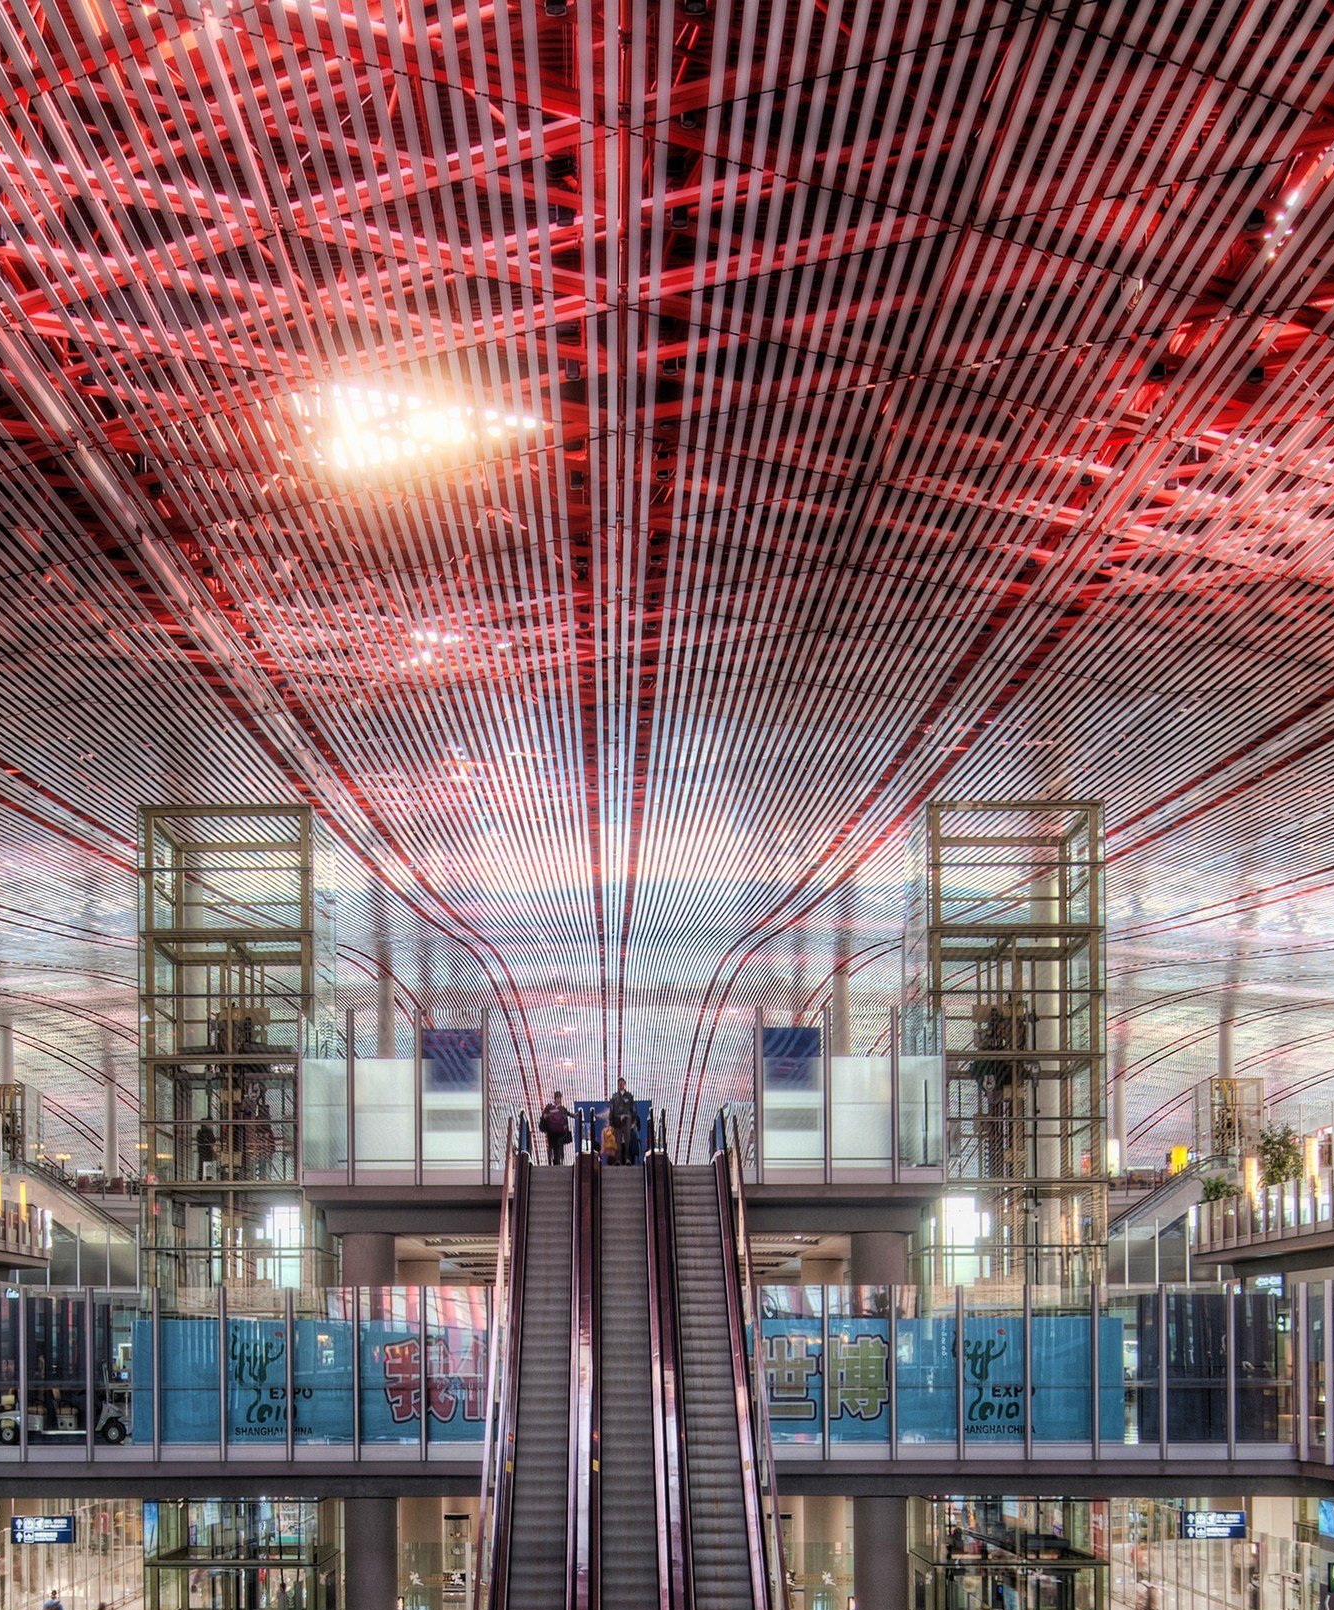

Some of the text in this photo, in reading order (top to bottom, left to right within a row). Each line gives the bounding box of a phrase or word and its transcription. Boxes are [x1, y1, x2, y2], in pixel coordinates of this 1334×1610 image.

[992, 1386, 1036, 1398] EXP
[235, 1426, 313, 1436] SHANGHAI HINA
[963, 1425, 1036, 1434] HANGHAI CHIA
